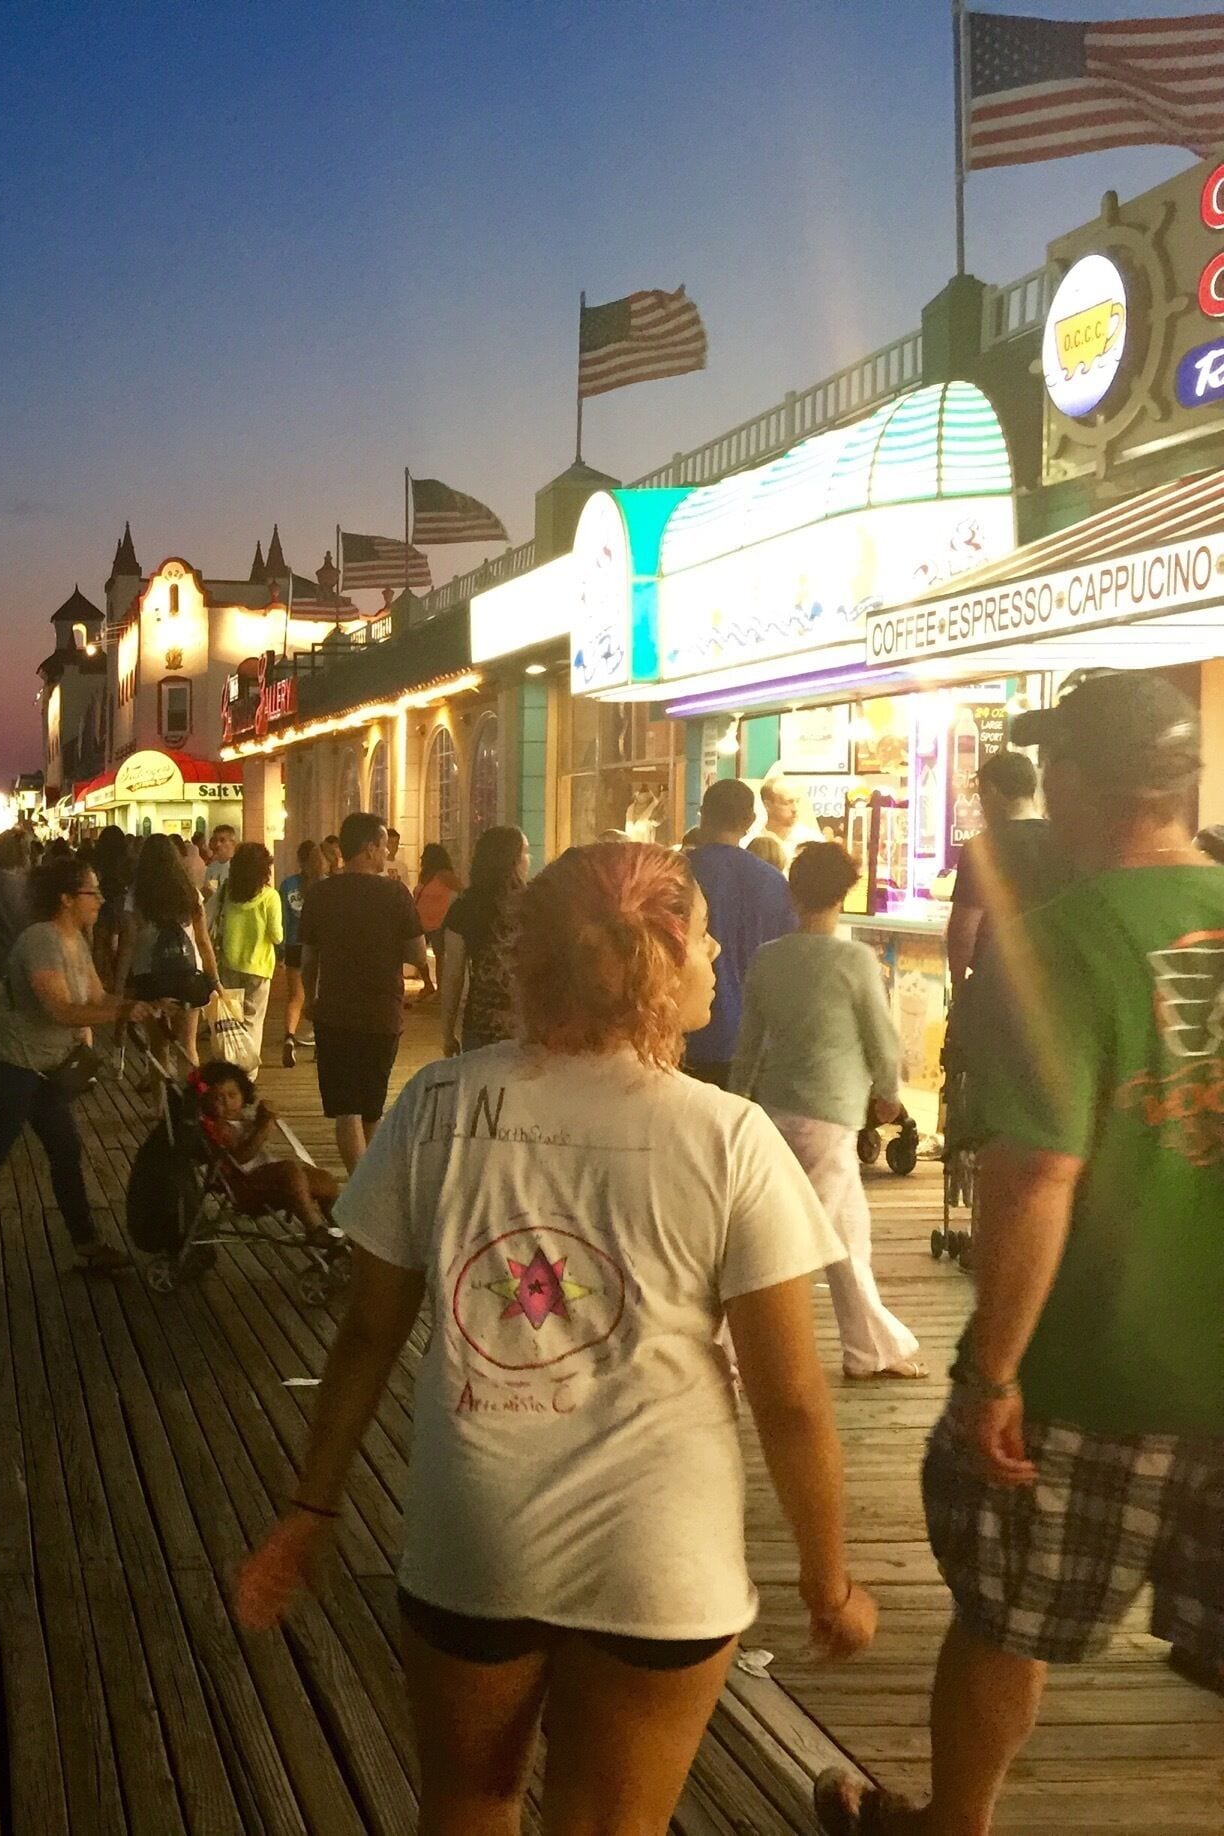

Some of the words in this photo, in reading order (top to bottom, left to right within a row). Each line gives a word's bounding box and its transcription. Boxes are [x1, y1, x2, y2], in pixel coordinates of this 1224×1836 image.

[871, 610, 937, 657] COFFEE
[948, 583, 1053, 642] ESPRESSO
[1067, 545, 1213, 617] CAPPUCINO
[981, 720, 1003, 730] LARGE
[980, 732, 1004, 742] SPORT
[984, 743, 1000, 754] TOP
[198, 785, 229, 797] Salt
